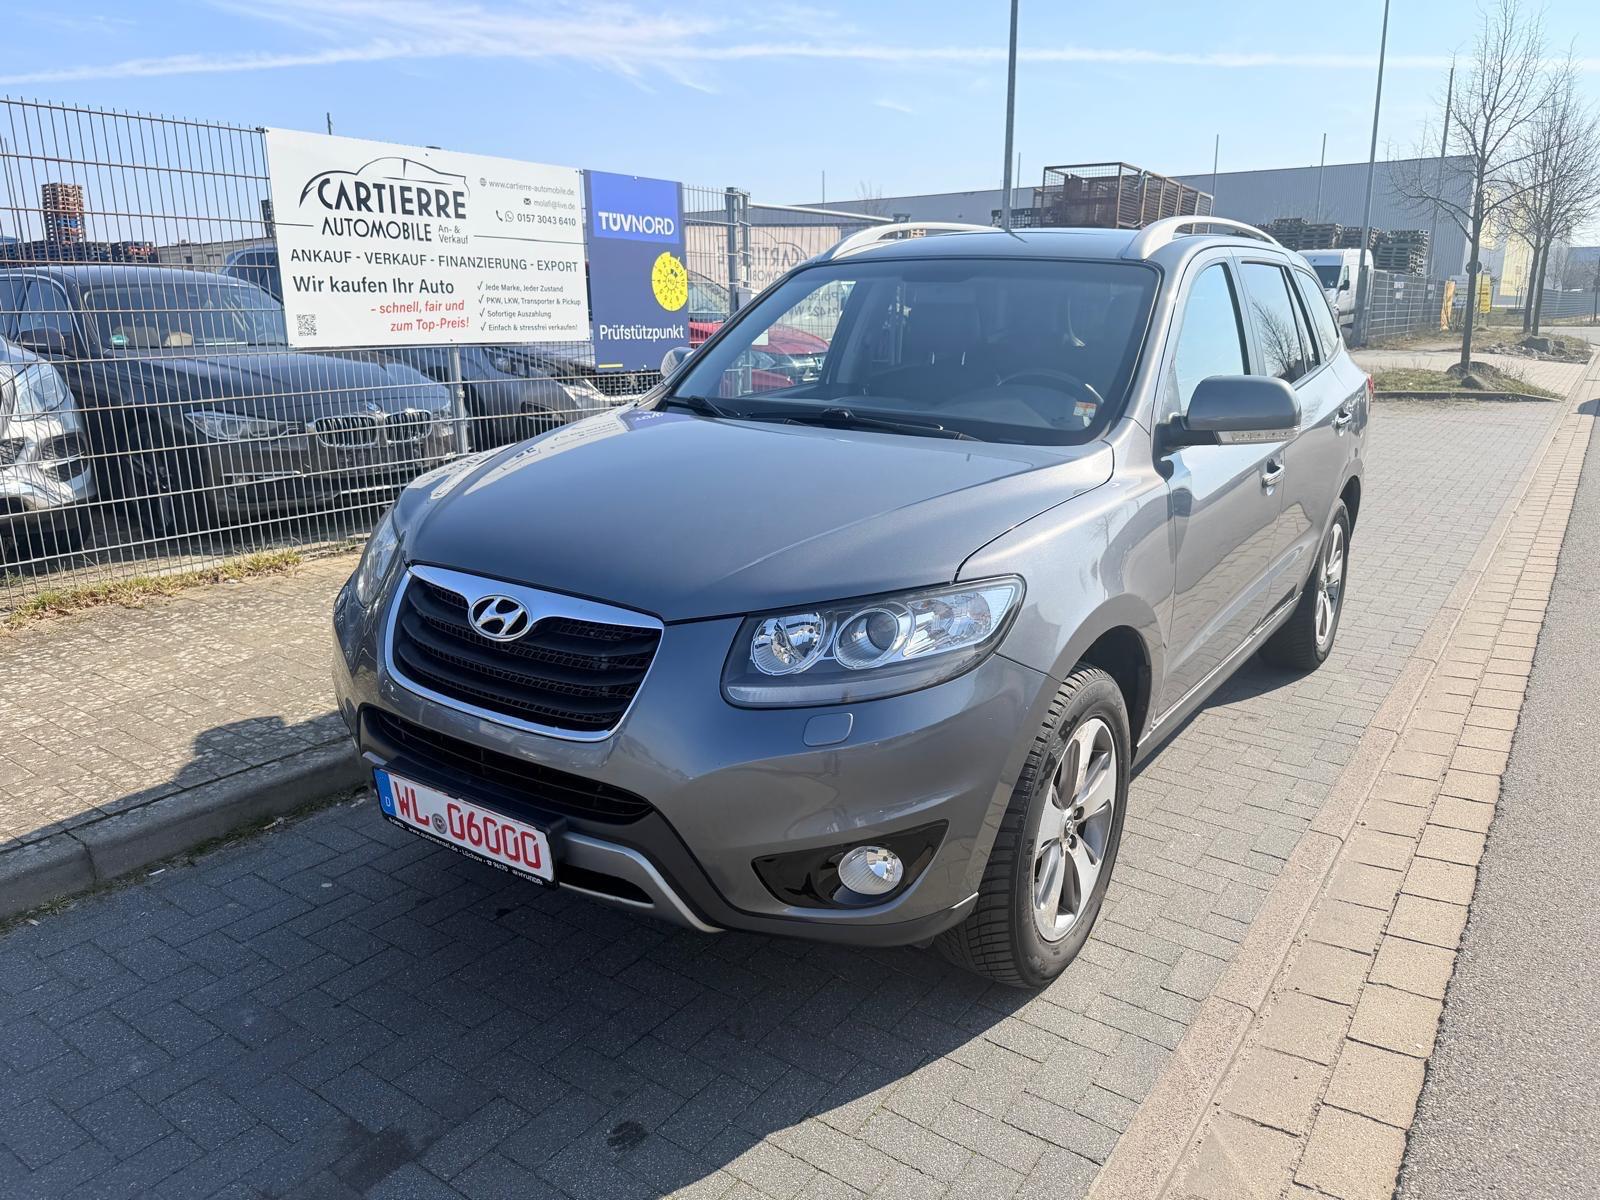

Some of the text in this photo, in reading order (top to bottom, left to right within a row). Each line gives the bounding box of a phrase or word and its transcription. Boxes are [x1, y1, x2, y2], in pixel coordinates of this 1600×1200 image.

[488, 180, 575, 196] www.cartierre-automobile.de
[317, 177, 467, 220] CARTIERRE
[517, 213, 576, 226] 0157 3043 6410
[322, 216, 432, 242] AUTOMOBILE
[438, 224, 452, 234] An-
[438, 234, 469, 245] Verkauf
[290, 248, 352, 264] ANKAUF
[364, 252, 427, 266] VERKAUF
[438, 255, 527, 271] FINANZIERUNG
[537, 260, 579, 273] EXPORT
[292, 276, 454, 294] Wir kaufen Ihr Auto
[501, 284, 522, 292] Marke,
[523, 284, 540, 292] Jeder
[379, 301, 422, 314] schnell,
[424, 300, 442, 312] fair
[445, 300, 464, 312] und
[520, 297, 554, 306] Transporter
[562, 298, 582, 306] Pickup
[487, 310, 552, 319] Sofortige Auszahlung
[390, 317, 470, 333] zum Top-Preis!
[600, 323, 685, 344] Prüfstützpunkt
[385, 796, 391, 808] D
[393, 780, 542, 870] WL 06000
